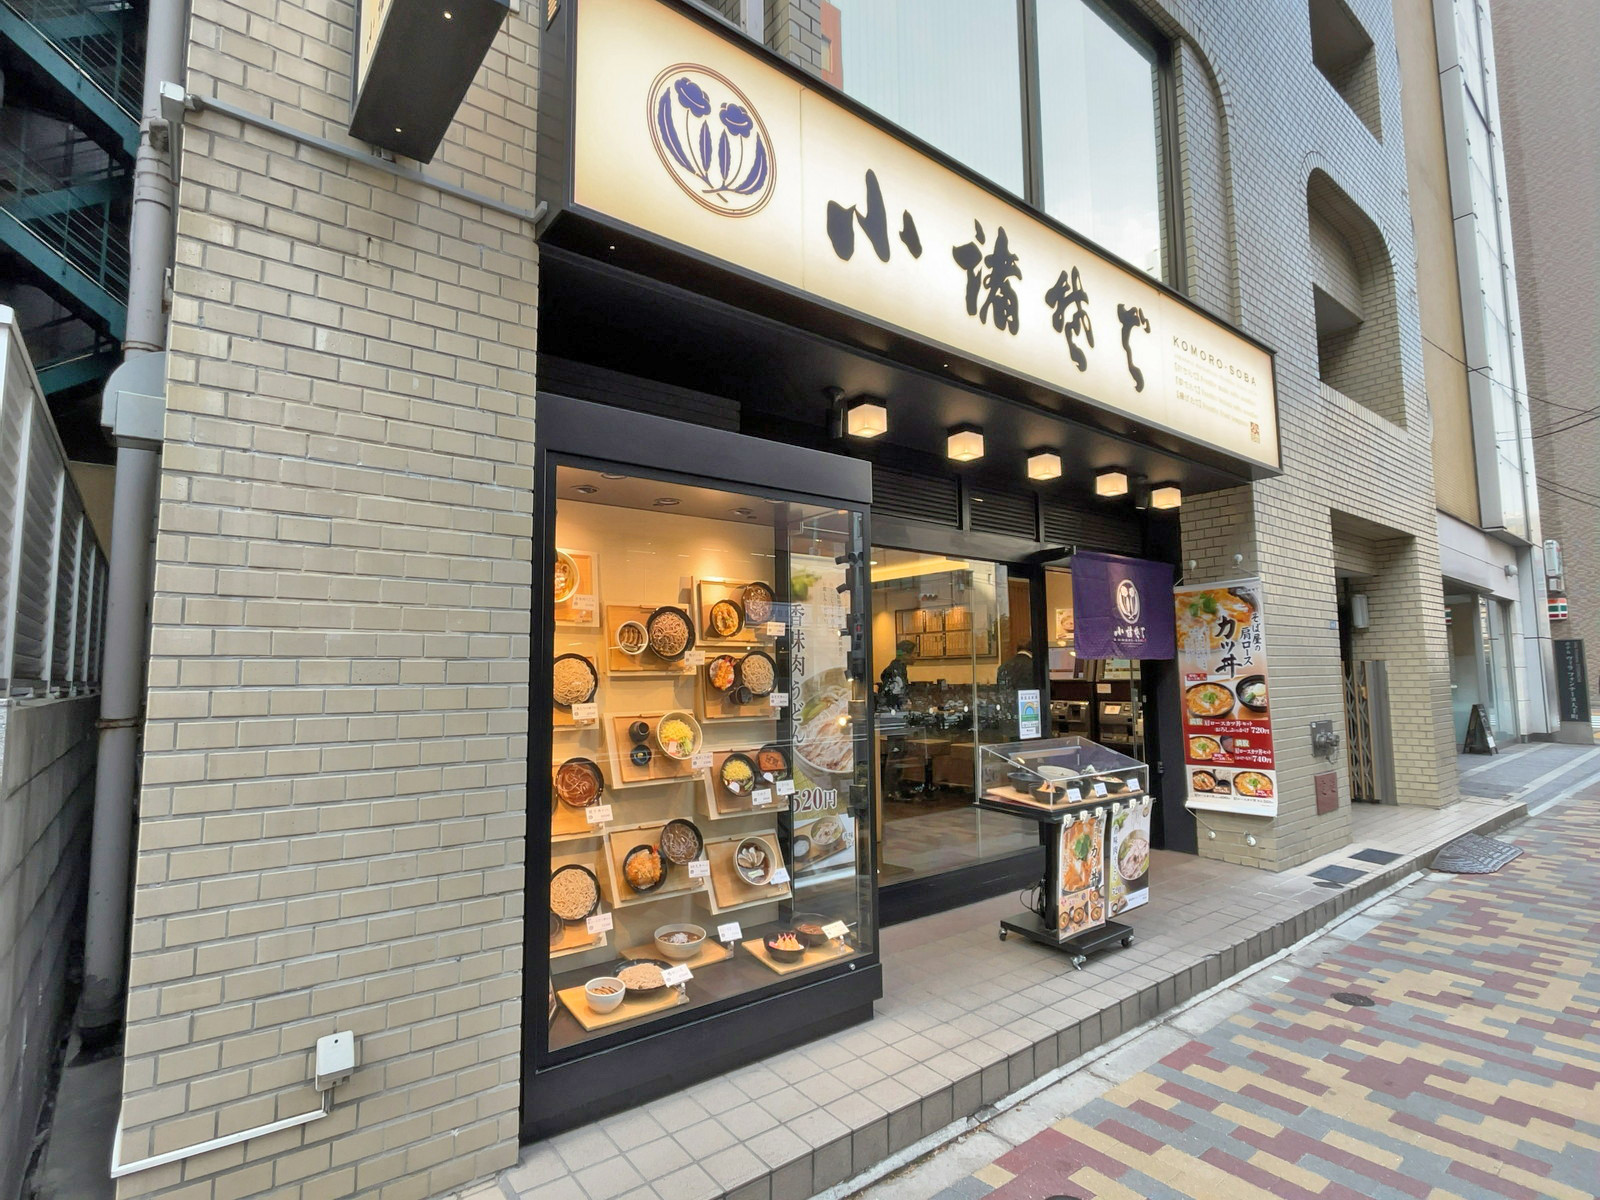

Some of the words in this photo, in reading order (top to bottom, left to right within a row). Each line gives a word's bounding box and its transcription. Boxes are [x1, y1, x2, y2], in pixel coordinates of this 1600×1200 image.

[1240, 627, 1253, 666] 肩ロース
[1251, 613, 1261, 652] そば屋の
[790, 603, 806, 745] 香味肉うどん
[1251, 727, 1270, 735] 720円
[1252, 755, 1272, 764] 740円
